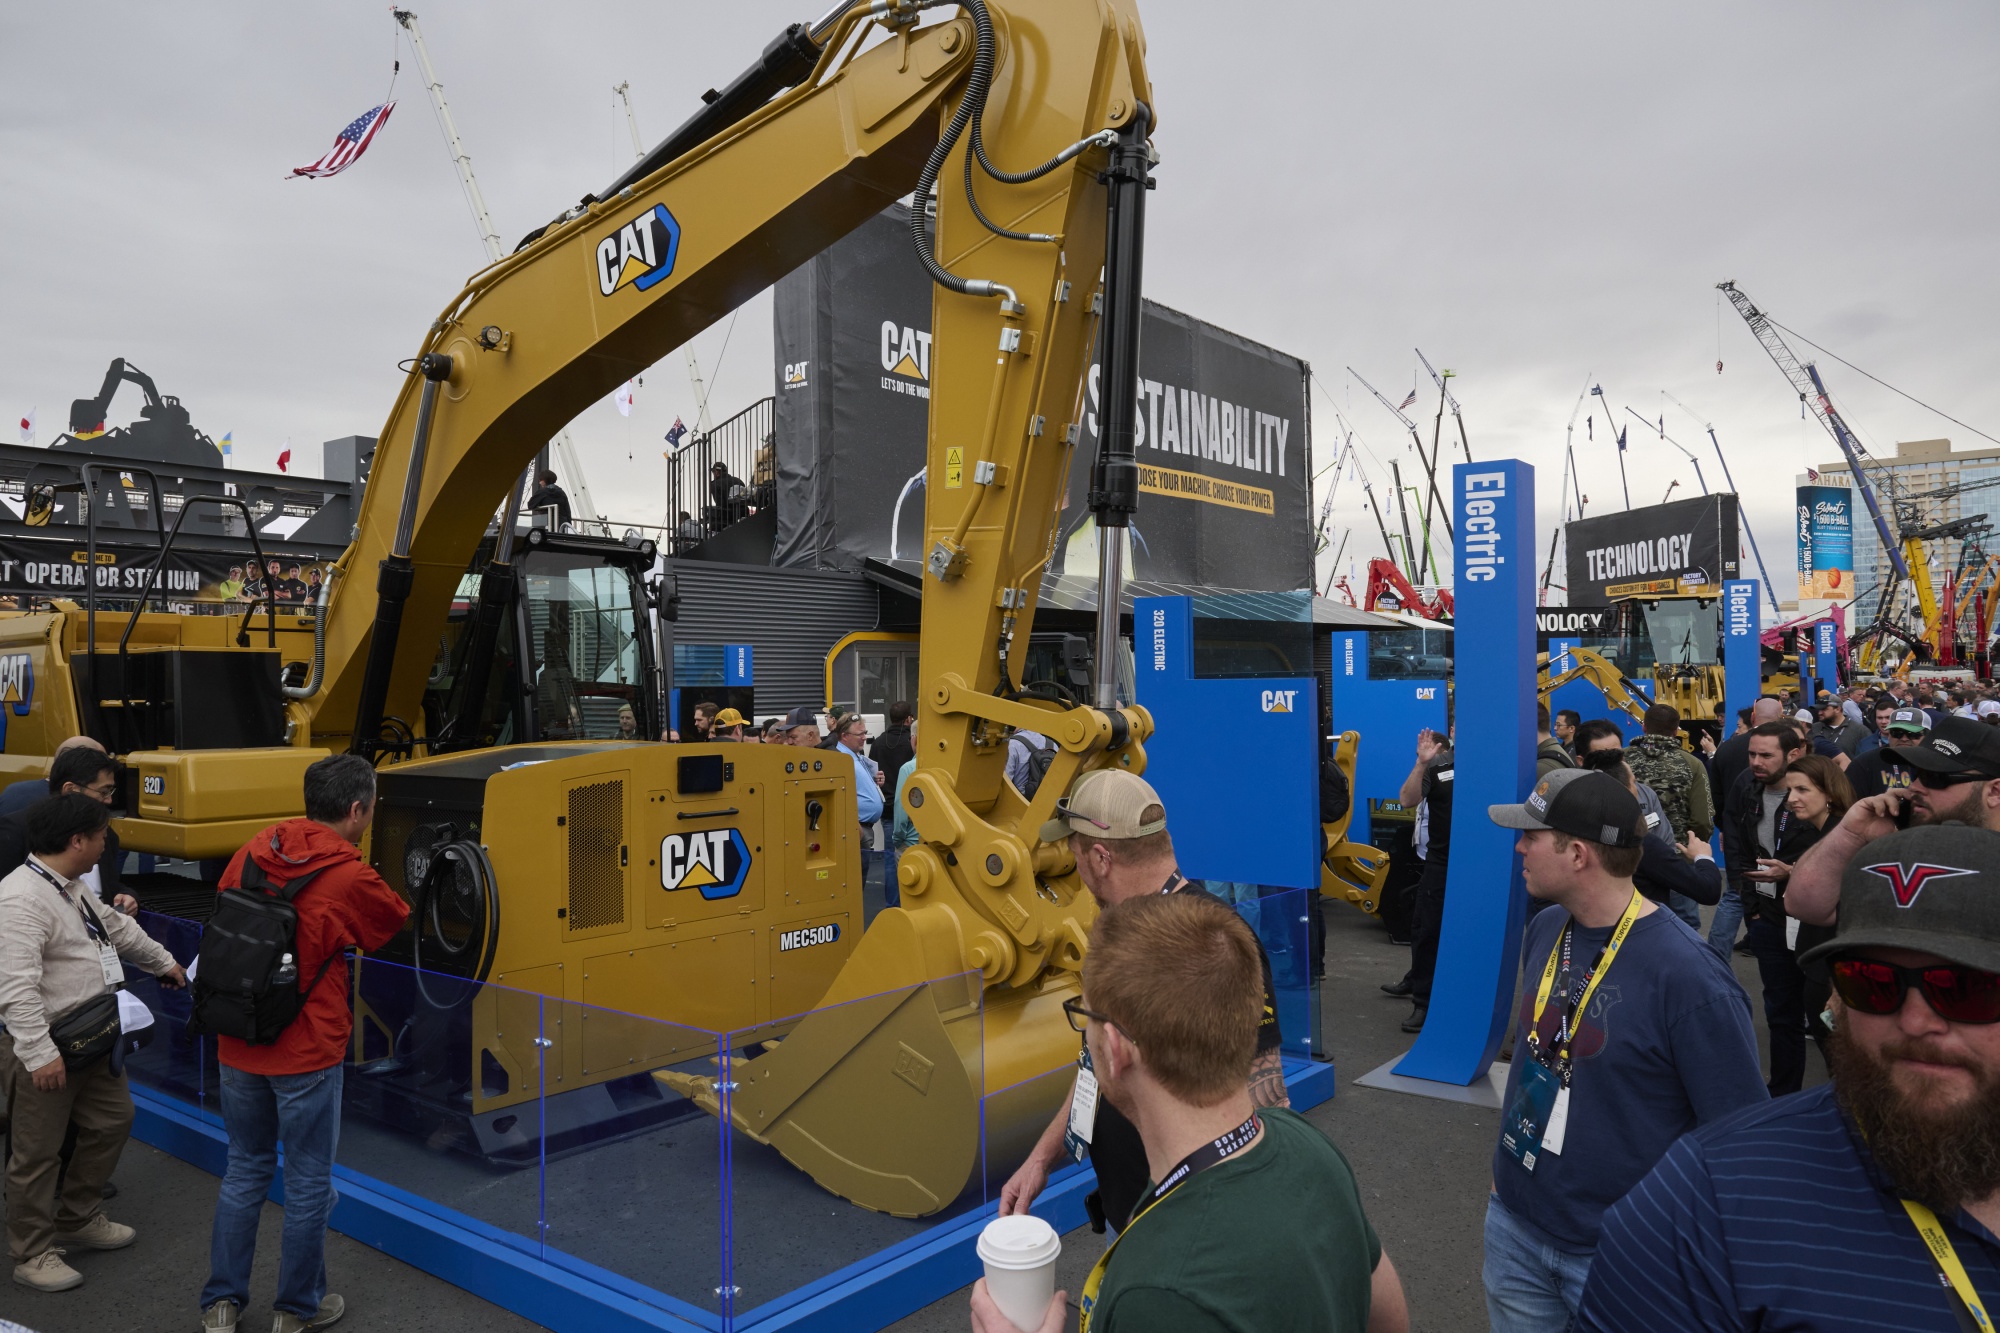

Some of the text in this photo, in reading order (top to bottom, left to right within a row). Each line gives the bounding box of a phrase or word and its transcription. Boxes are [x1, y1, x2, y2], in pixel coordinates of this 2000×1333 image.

[597, 208, 656, 294] CAT
[882, 320, 932, 380] CAT
[785, 361, 807, 382] CAT
[882, 376, 930, 399] LET'S DO THE WOR
[1088, 364, 1290, 476] SSTAINABILITY
[1138, 467, 1272, 510] OOSE YOUR MACHINE. CHOOSE YOUR POWER.
[1465, 472, 1506, 582] Electric
[1586, 533, 1692, 581] TECHNOLOGY
[25, 562, 119, 588] OPERAOR
[1536, 613, 1602, 632] NOLOGY
[1730, 584, 1752, 636] Electric
[1154, 610, 1165, 670] 320 ELECTRIC
[1820, 624, 1833, 654] Electric
[1, 655, 27, 701] CAT
[1262, 690, 1294, 712] CAT
[1416, 688, 1434, 700] CAT
[144, 776, 160, 794] 320
[1530, 792, 1547, 809] EYER
[662, 830, 730, 891] CAT
[781, 924, 833, 950] MEC500
[1616, 917, 1632, 942] TOPCON
[1546, 953, 1556, 978] TOPCON
[1219, 1127, 1256, 1156] CONEXPO
[1155, 1164, 1190, 1197] LIEBHERR
